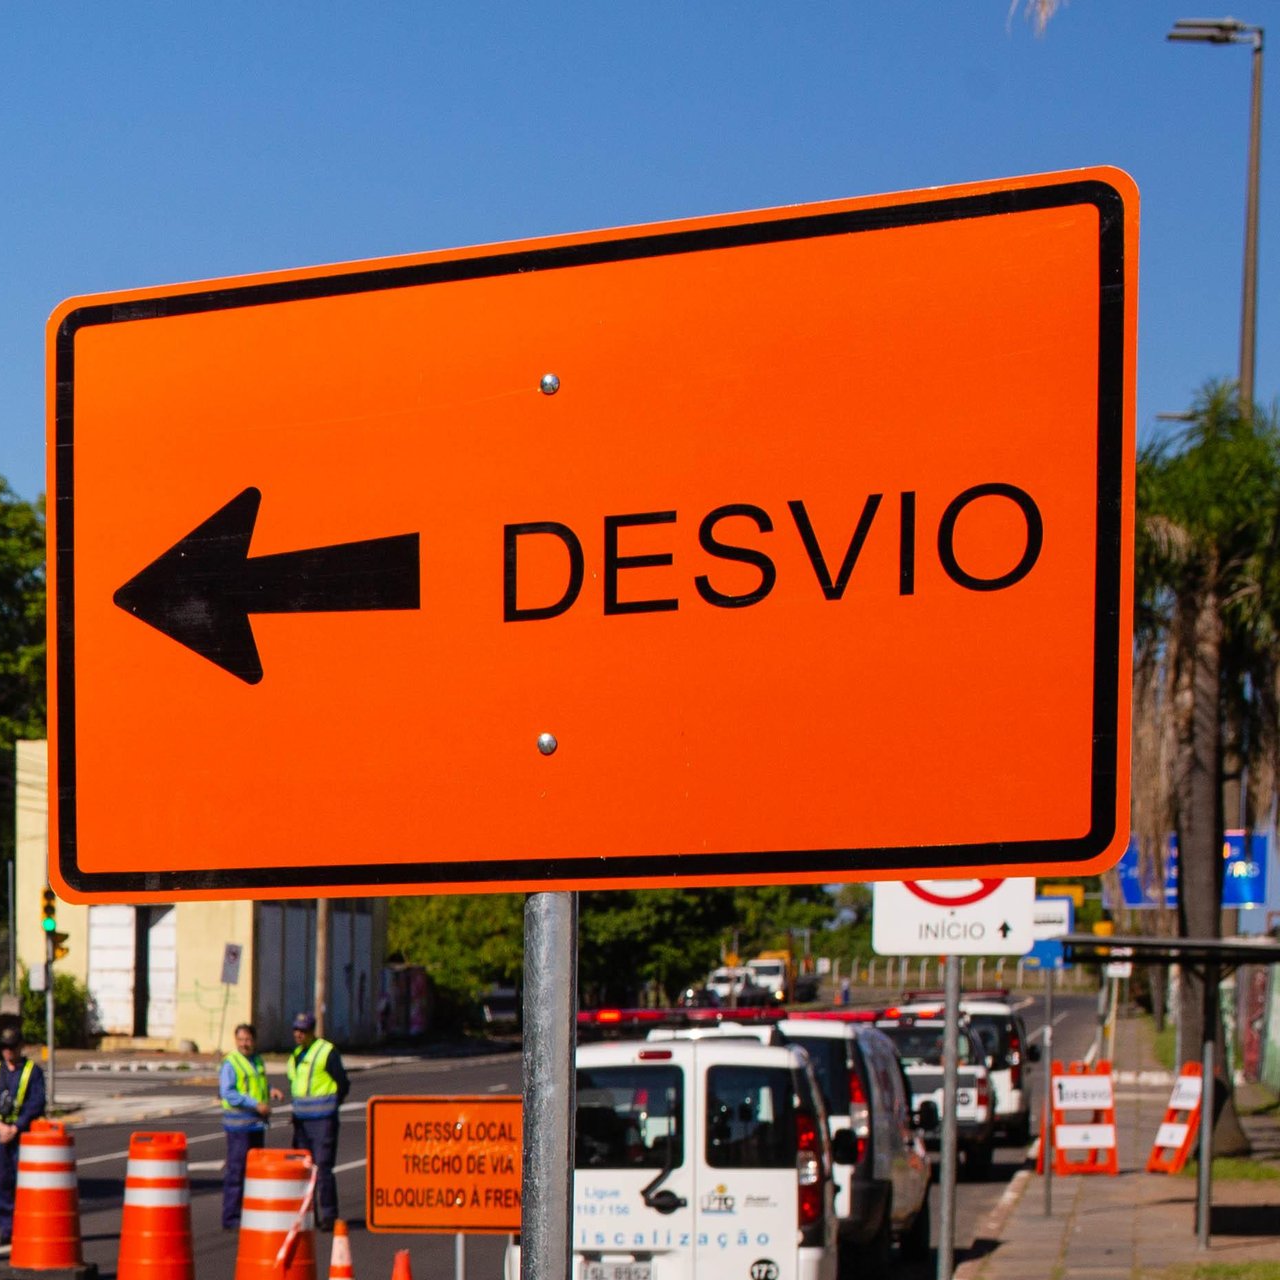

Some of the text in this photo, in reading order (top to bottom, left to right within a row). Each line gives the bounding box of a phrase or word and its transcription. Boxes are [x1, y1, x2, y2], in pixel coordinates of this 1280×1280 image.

[502, 482, 1044, 623] DESVIO
[918, 918, 986, 940] INÍCIO
[403, 1121, 517, 1142] ACESSO LOCAL
[403, 1154, 514, 1175] TRECHO DE VIA
[375, 1185, 522, 1208] BLOQUEADO À FREN
[581, 1228, 771, 1249] iscalização
